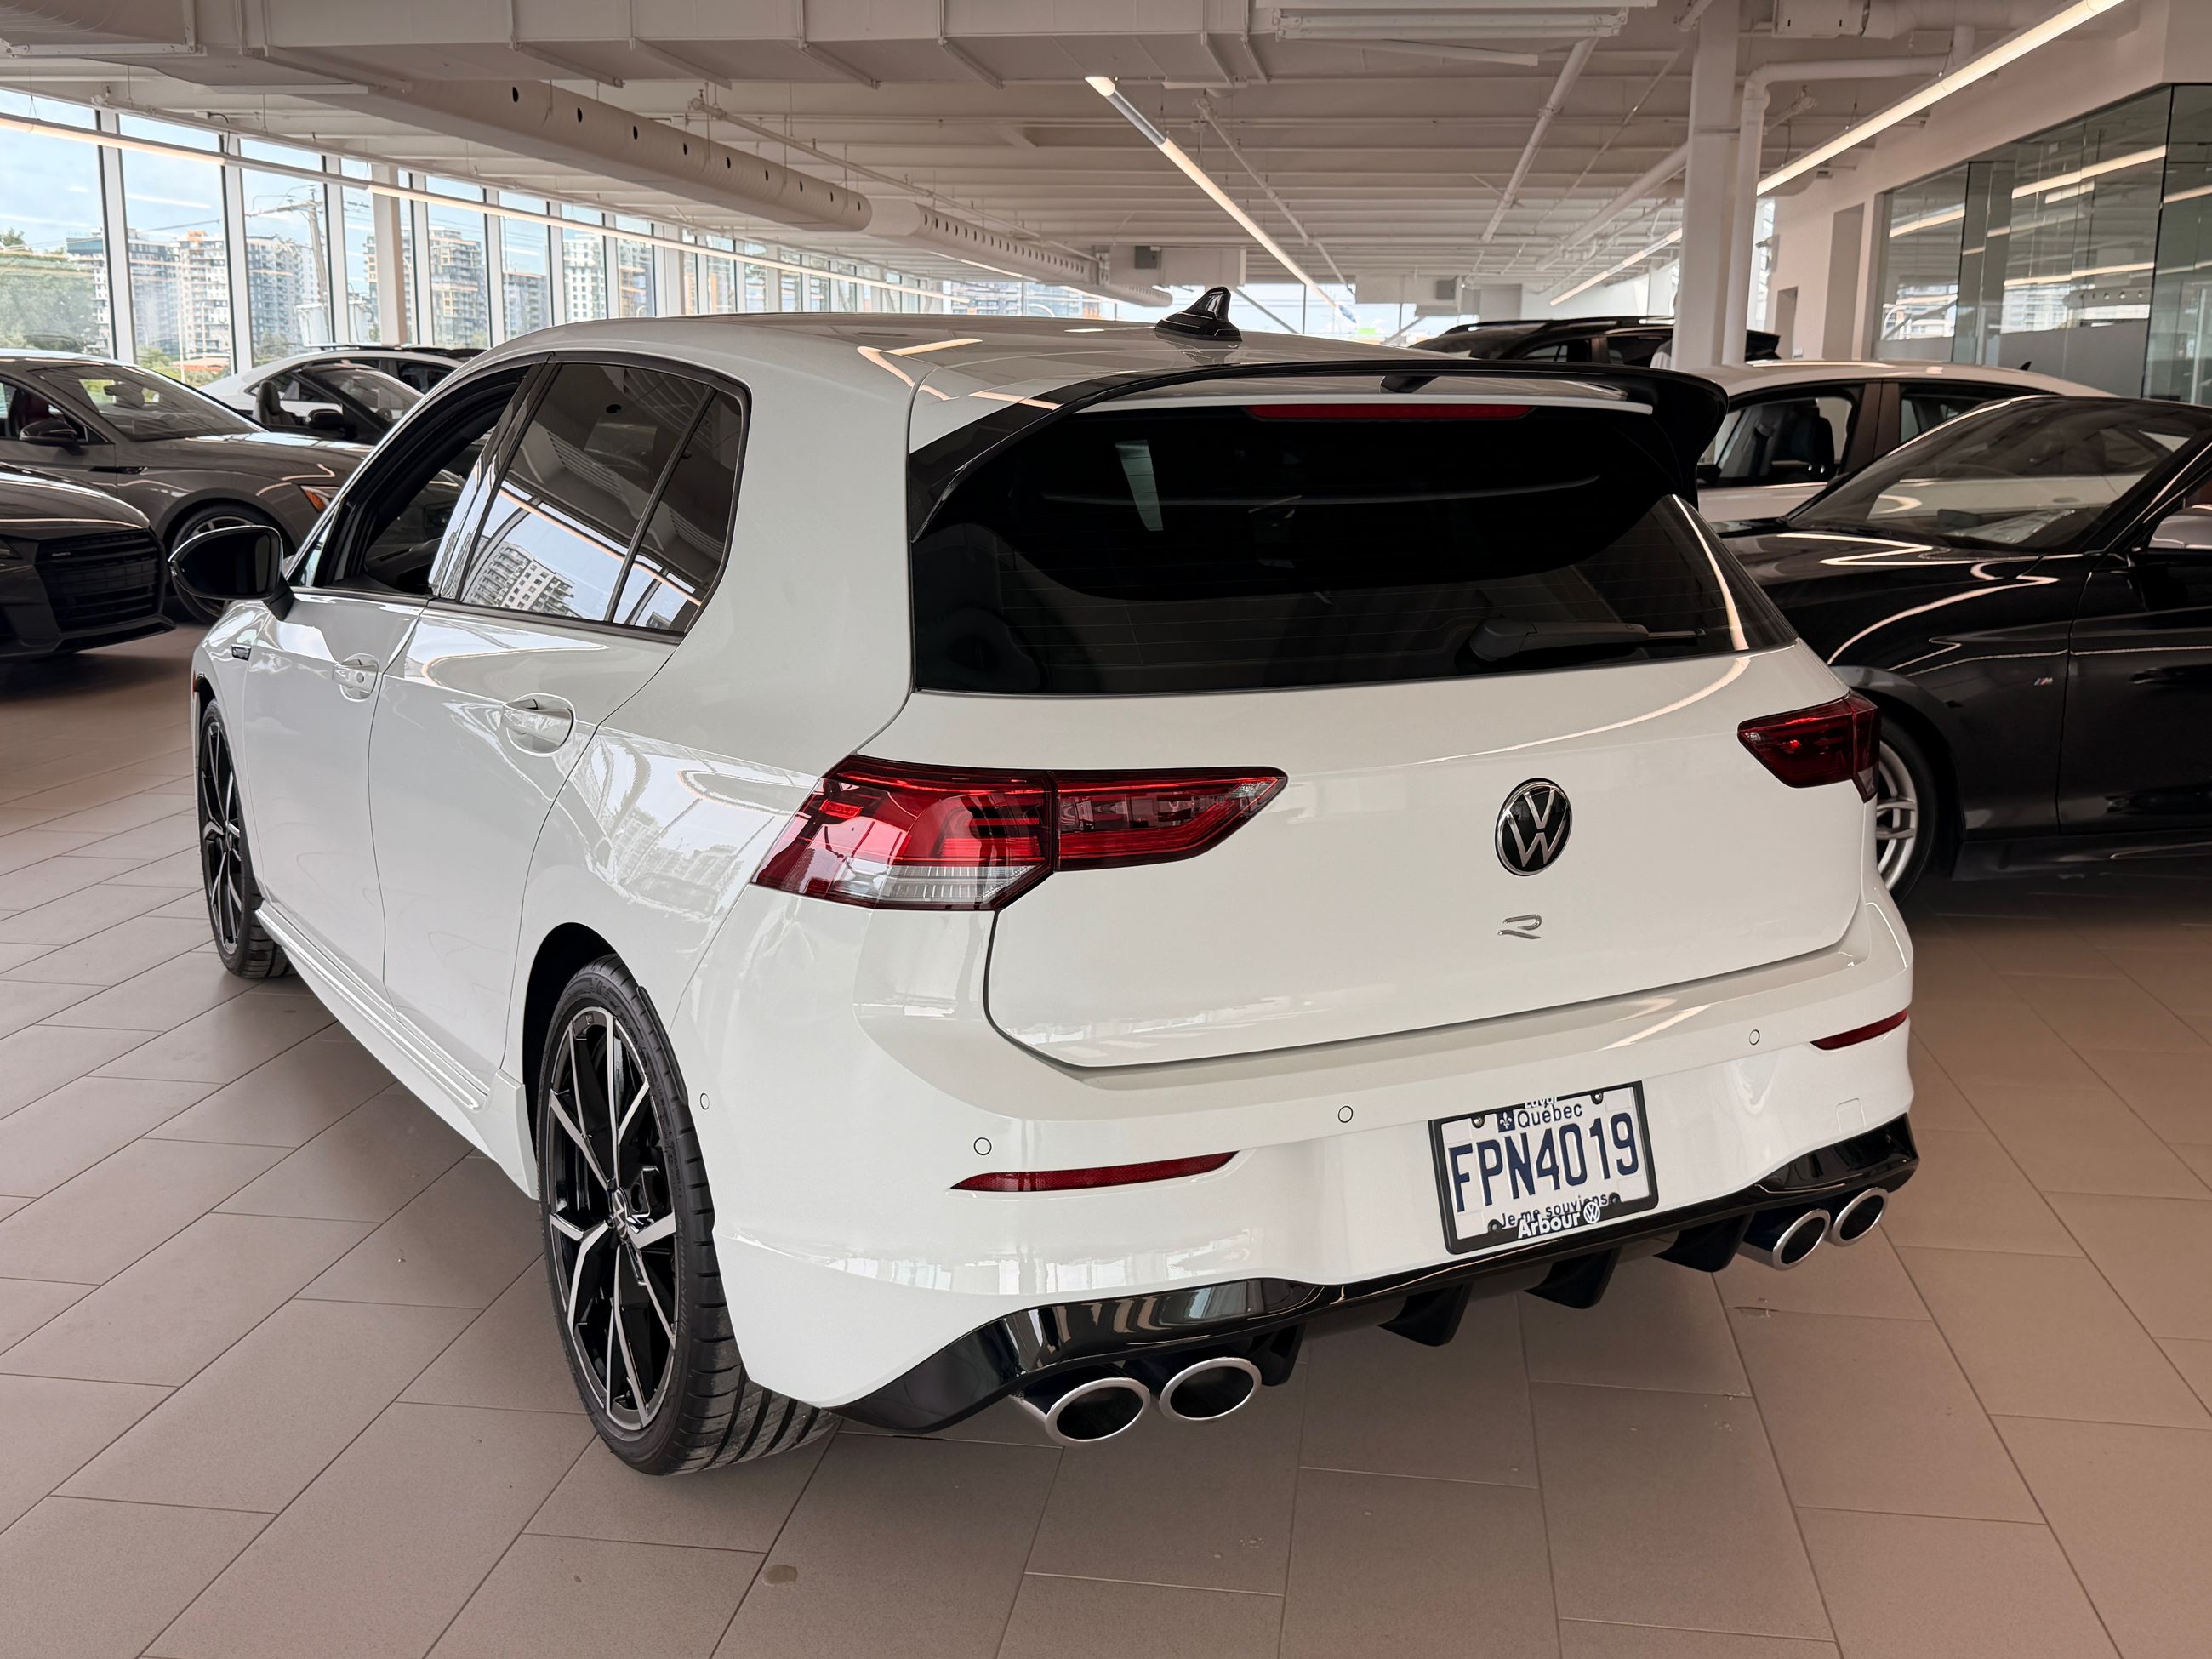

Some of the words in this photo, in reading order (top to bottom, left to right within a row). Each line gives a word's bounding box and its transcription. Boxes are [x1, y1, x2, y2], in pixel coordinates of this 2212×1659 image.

[1448, 1112, 1639, 1212] FPN4019
[1502, 1212, 1516, 1228] Je
[1518, 1211, 1581, 1239] Arbour
